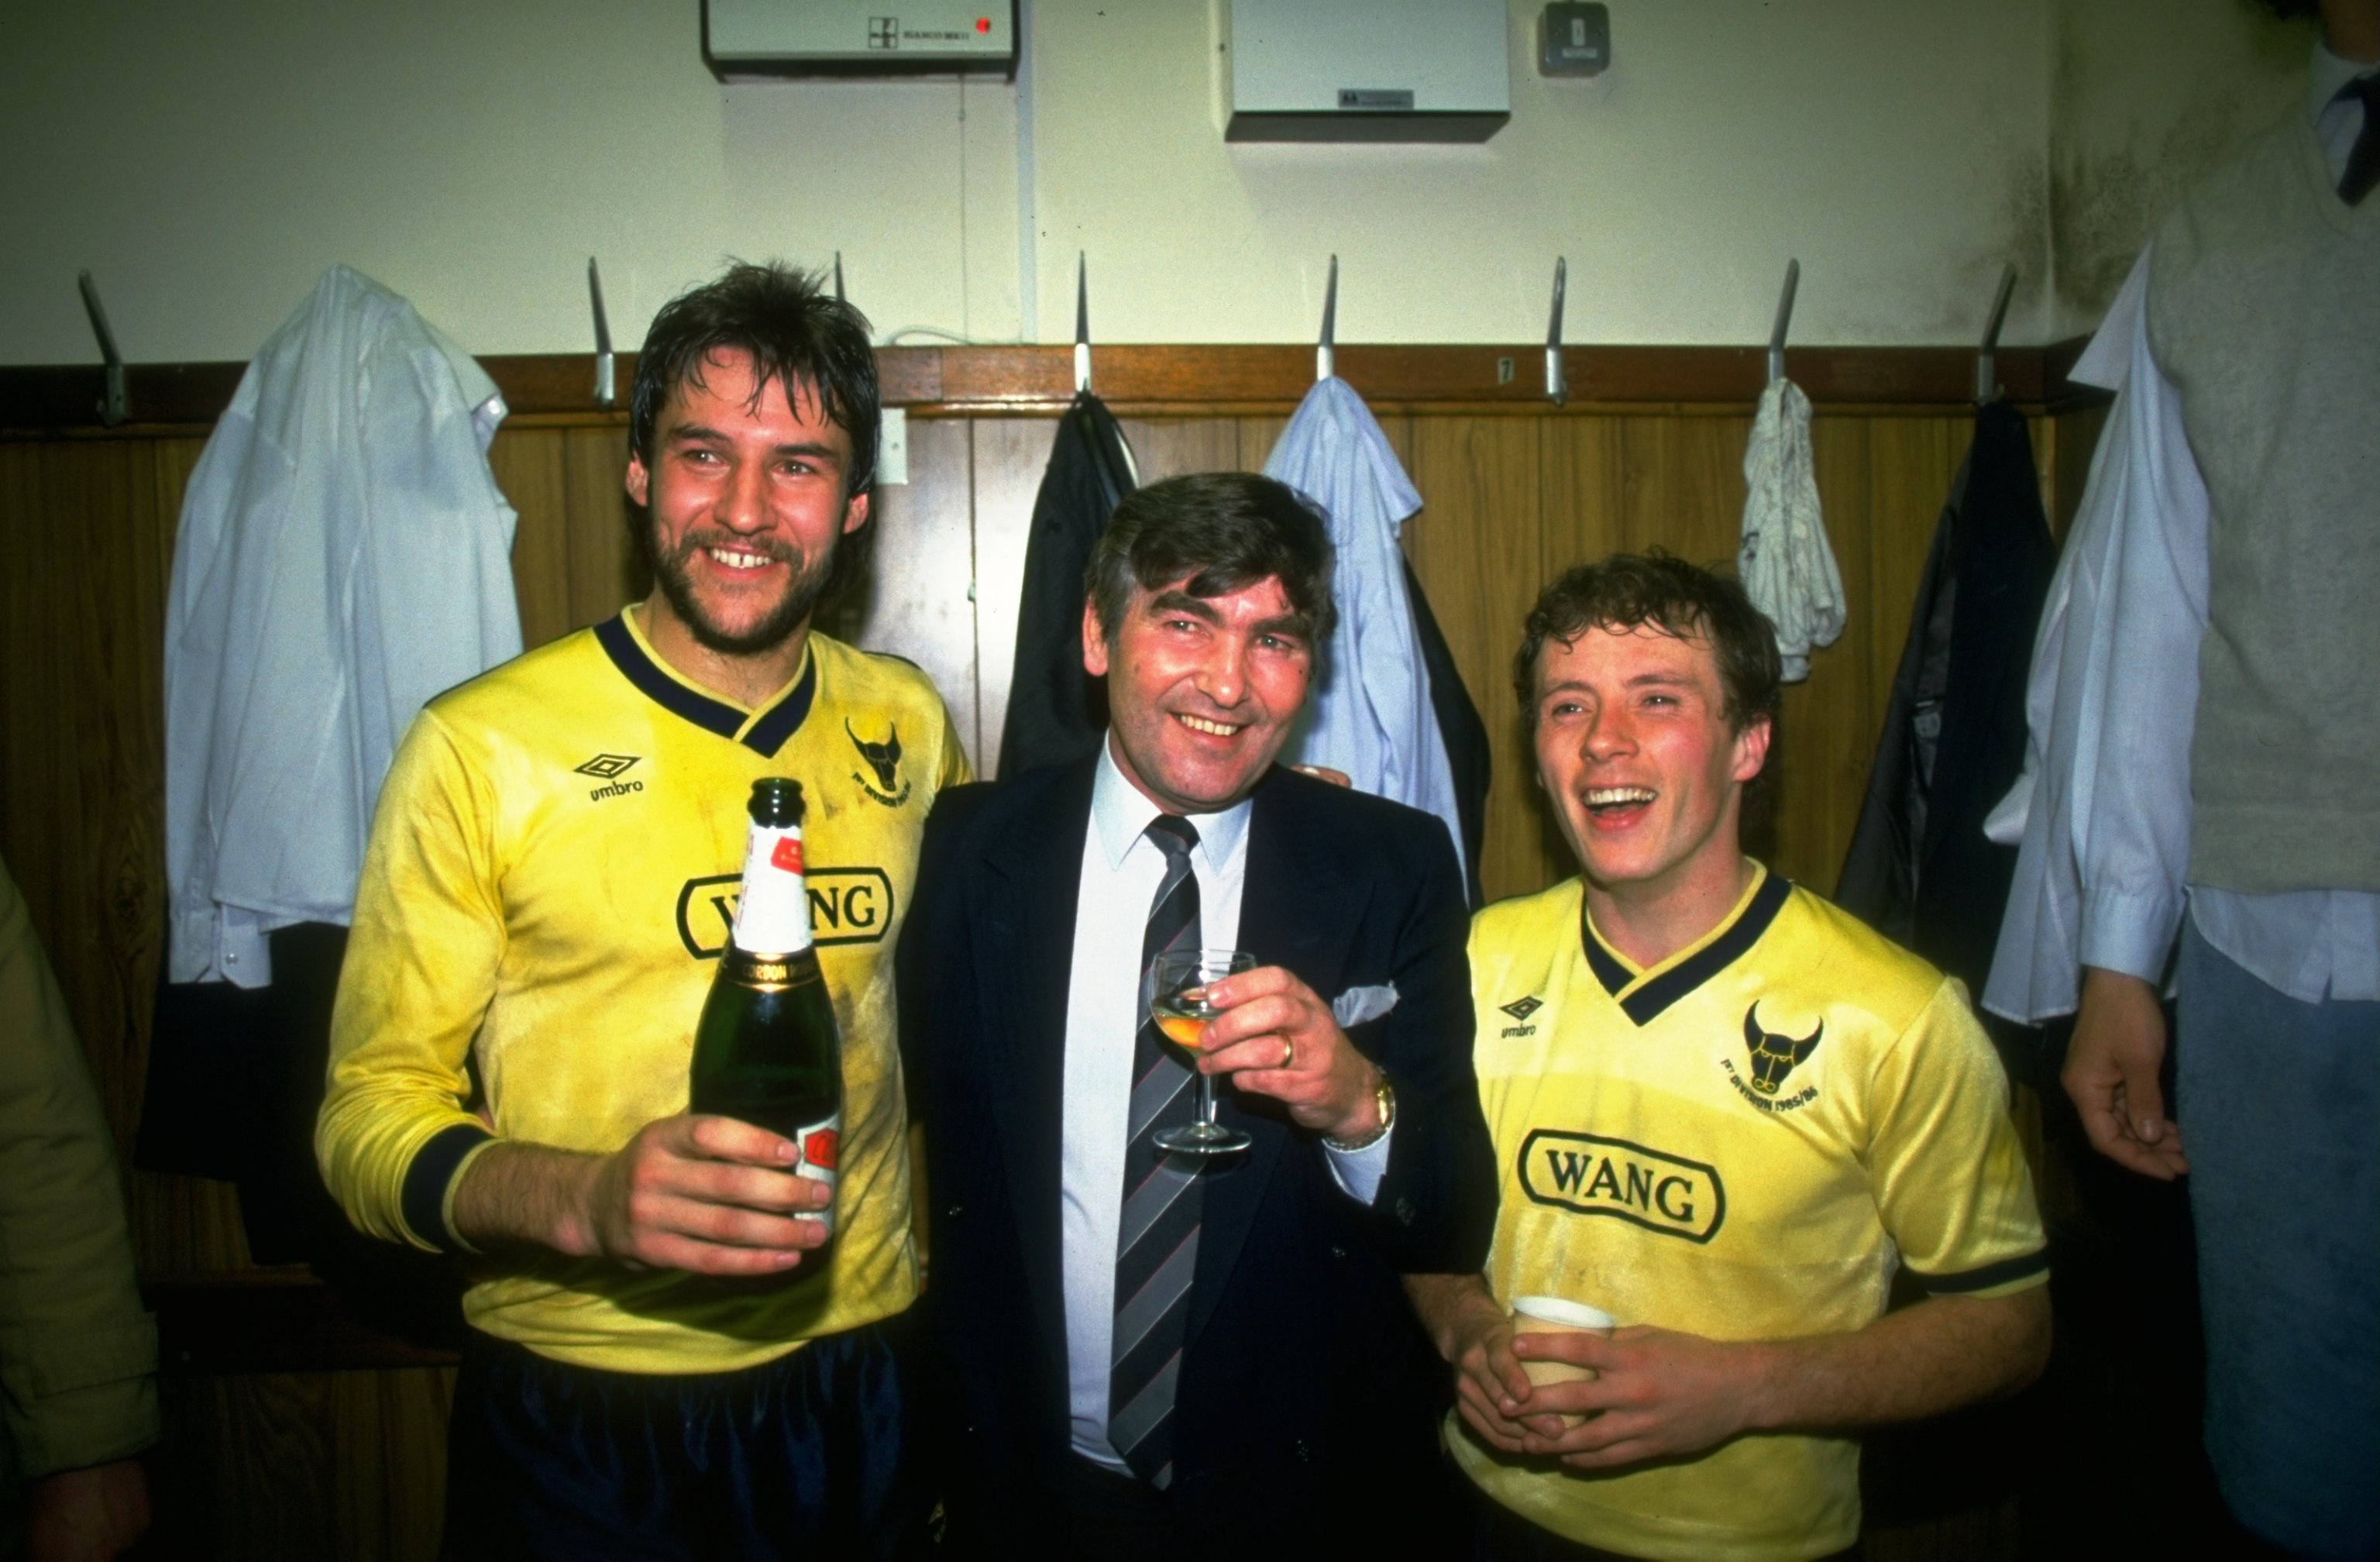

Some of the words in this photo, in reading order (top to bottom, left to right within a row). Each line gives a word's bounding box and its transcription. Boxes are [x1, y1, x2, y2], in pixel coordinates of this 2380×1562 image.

[1501, 360, 1510, 380] 7
[590, 780, 643, 801] umbro
[710, 885, 875, 931] WNG
[1501, 1022, 1536, 1038] umbro
[1730, 1075, 1773, 1111] DIVISION
[1775, 1085, 1818, 1112] 1985/86
[1546, 1149, 1694, 1222] WANG
